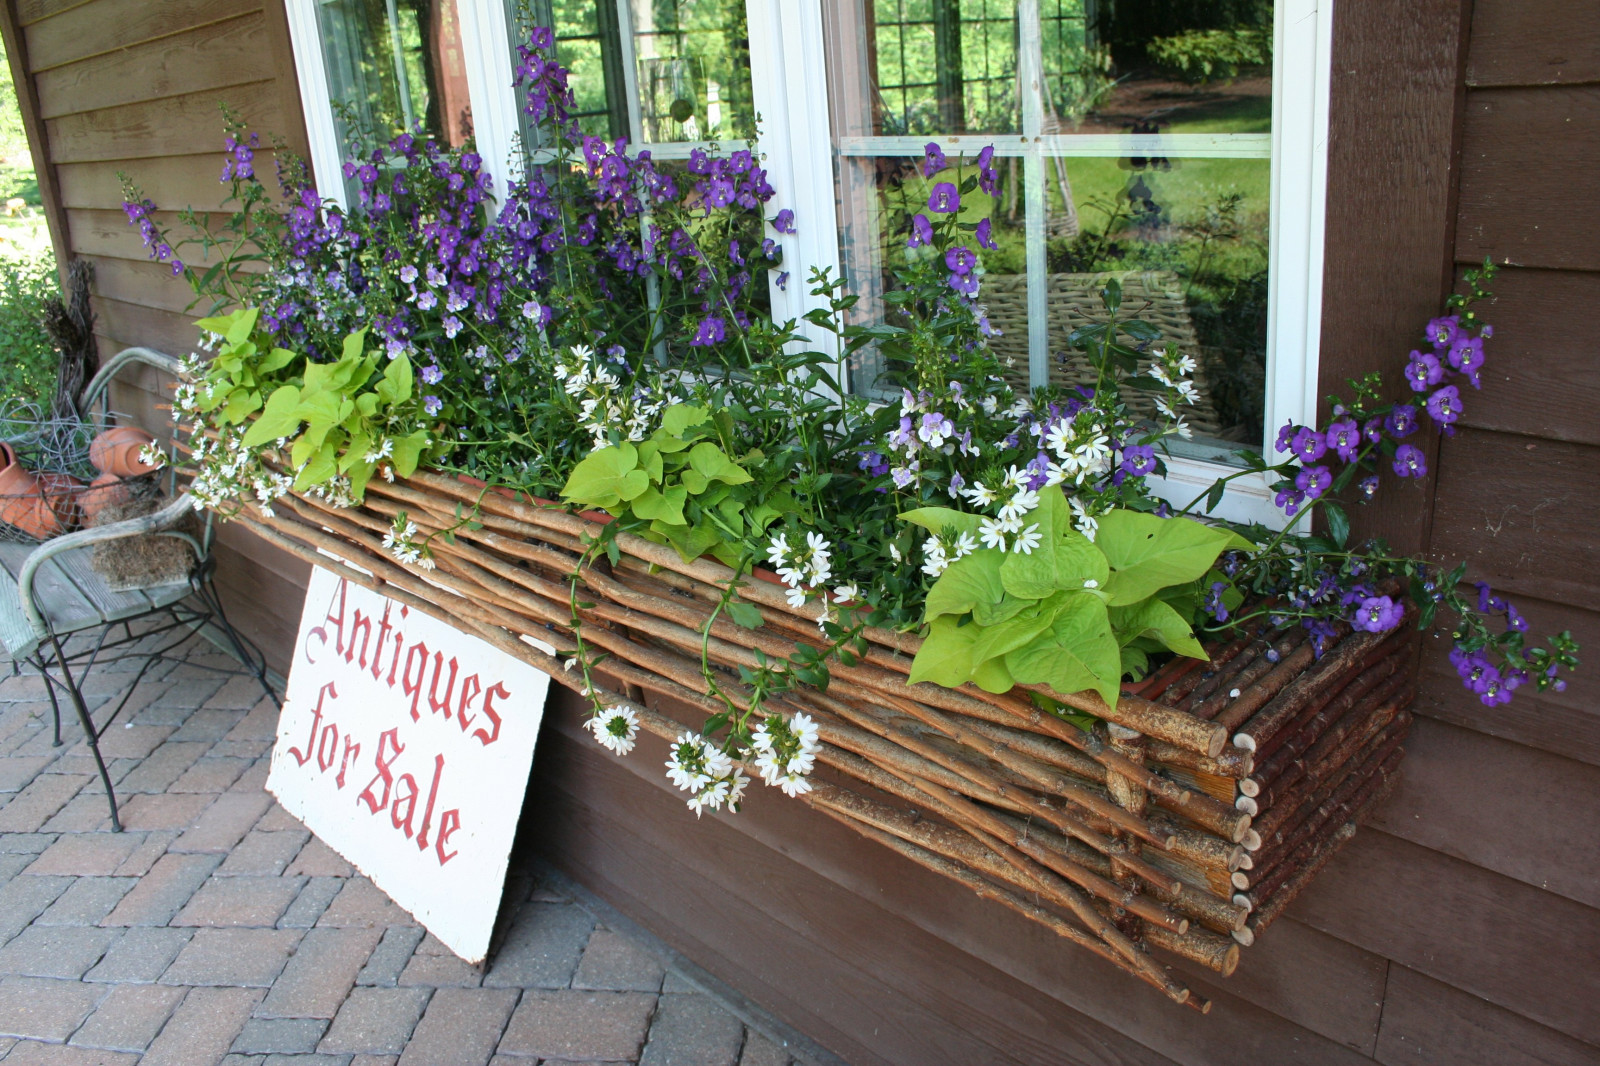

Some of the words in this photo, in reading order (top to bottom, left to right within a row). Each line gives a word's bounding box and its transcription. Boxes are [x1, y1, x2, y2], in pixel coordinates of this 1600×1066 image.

[305, 562, 511, 747] Antiques
[287, 681, 361, 790] for
[357, 727, 461, 866] Sale
